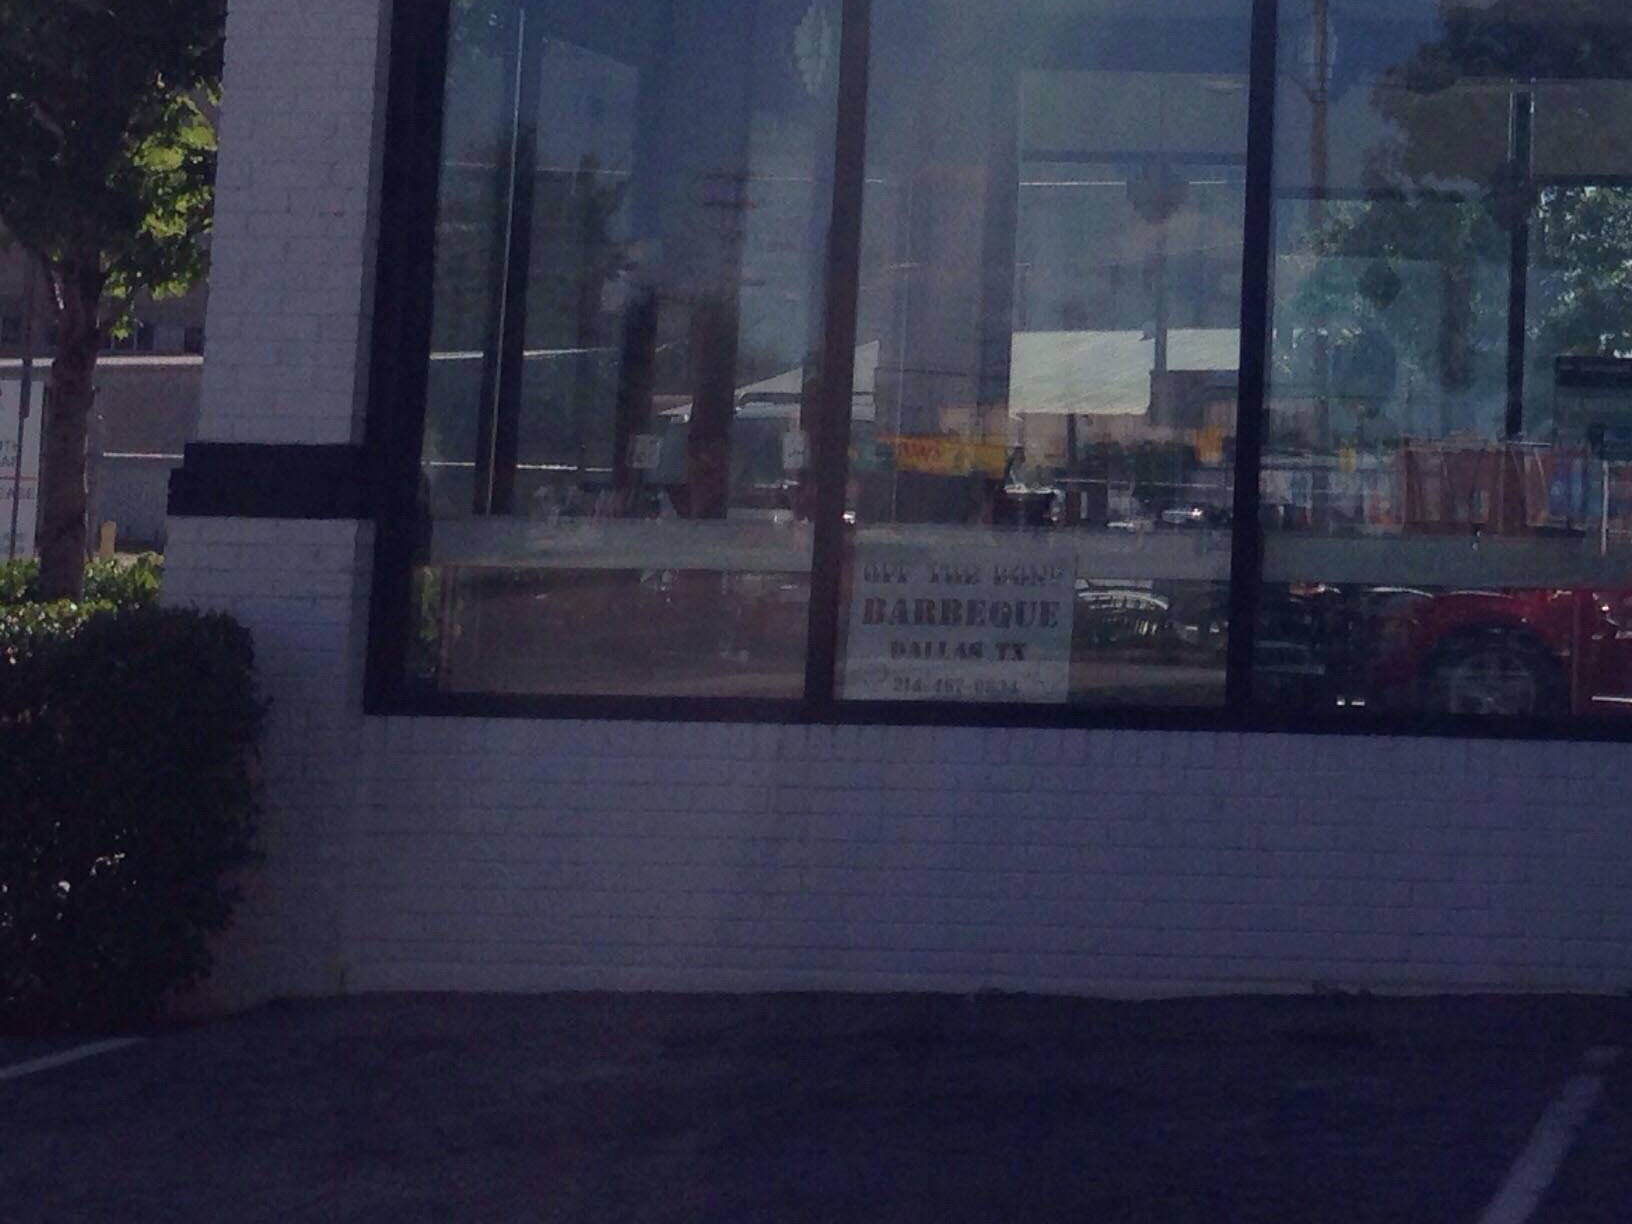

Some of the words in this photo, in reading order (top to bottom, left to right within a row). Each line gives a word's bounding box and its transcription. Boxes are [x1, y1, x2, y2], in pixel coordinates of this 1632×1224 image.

[861, 597, 1060, 629] BARBEQUE
[890, 640, 985, 660] DALLAS
[994, 641, 1027, 662] TX
